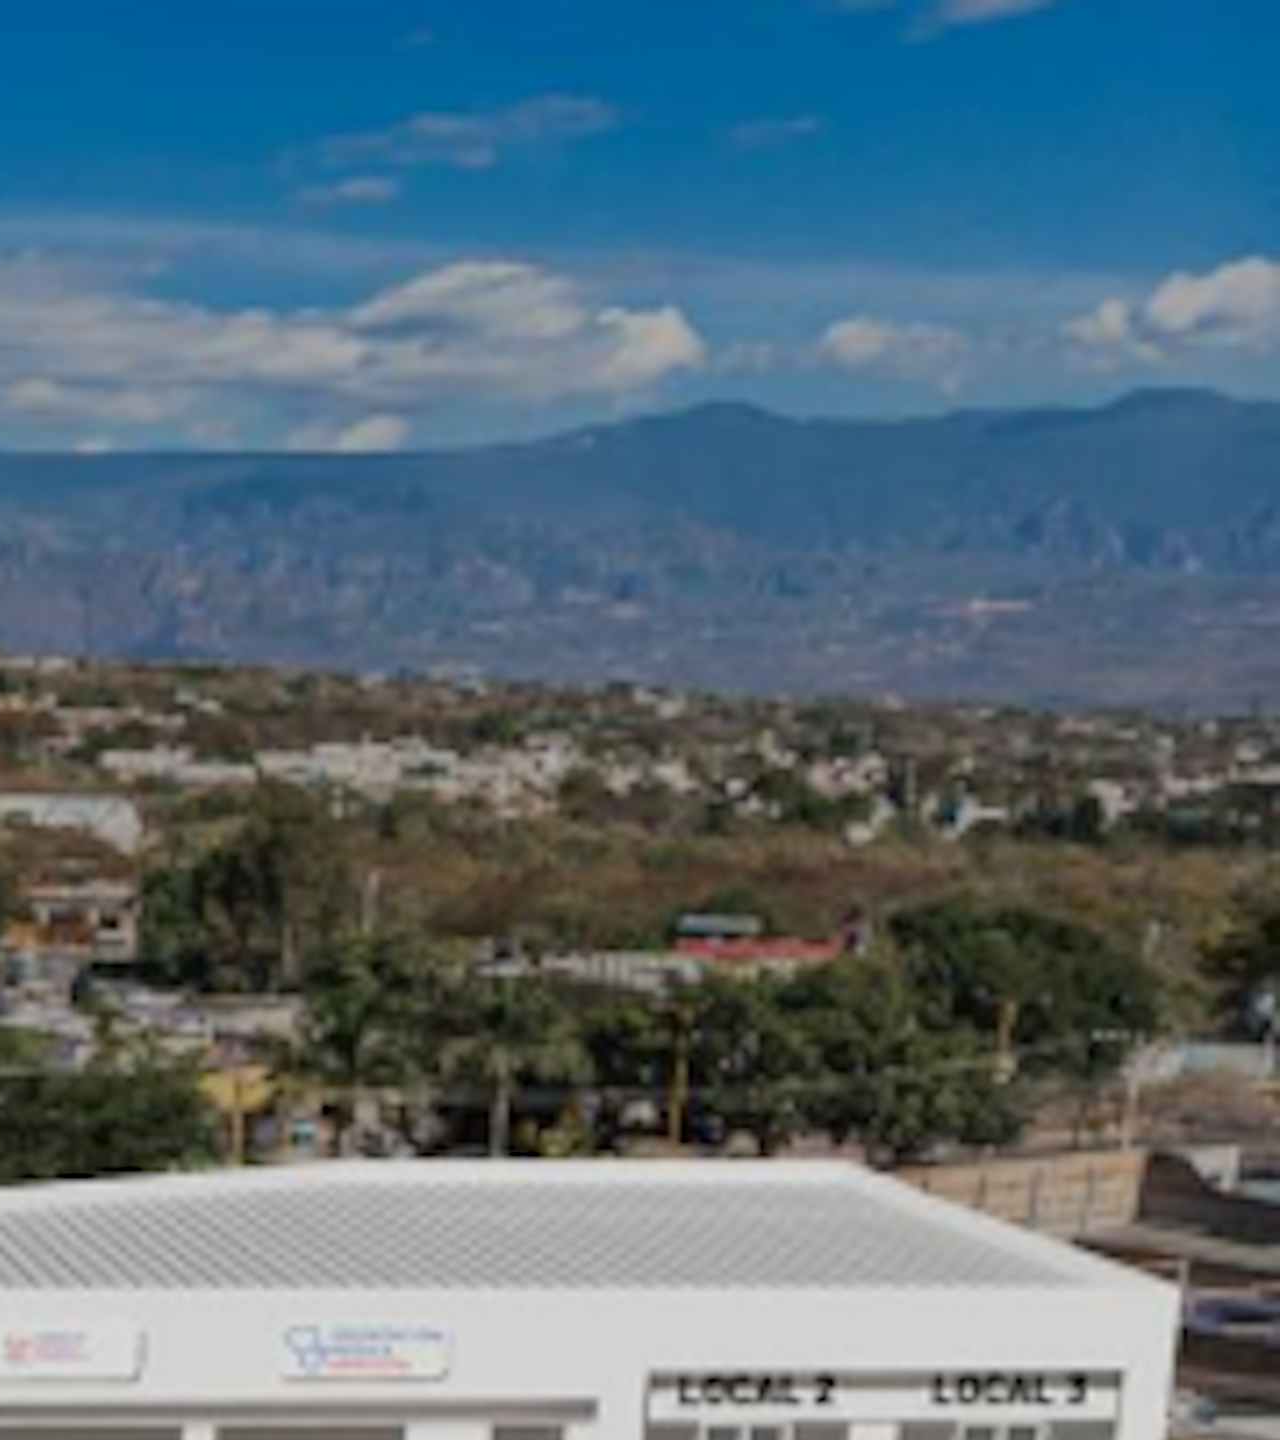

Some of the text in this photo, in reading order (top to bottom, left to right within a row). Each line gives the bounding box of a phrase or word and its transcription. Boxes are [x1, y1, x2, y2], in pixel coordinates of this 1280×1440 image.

[676, 1375, 836, 1405] LOCAL 2
[932, 1374, 1088, 1405] LOCAL 3
